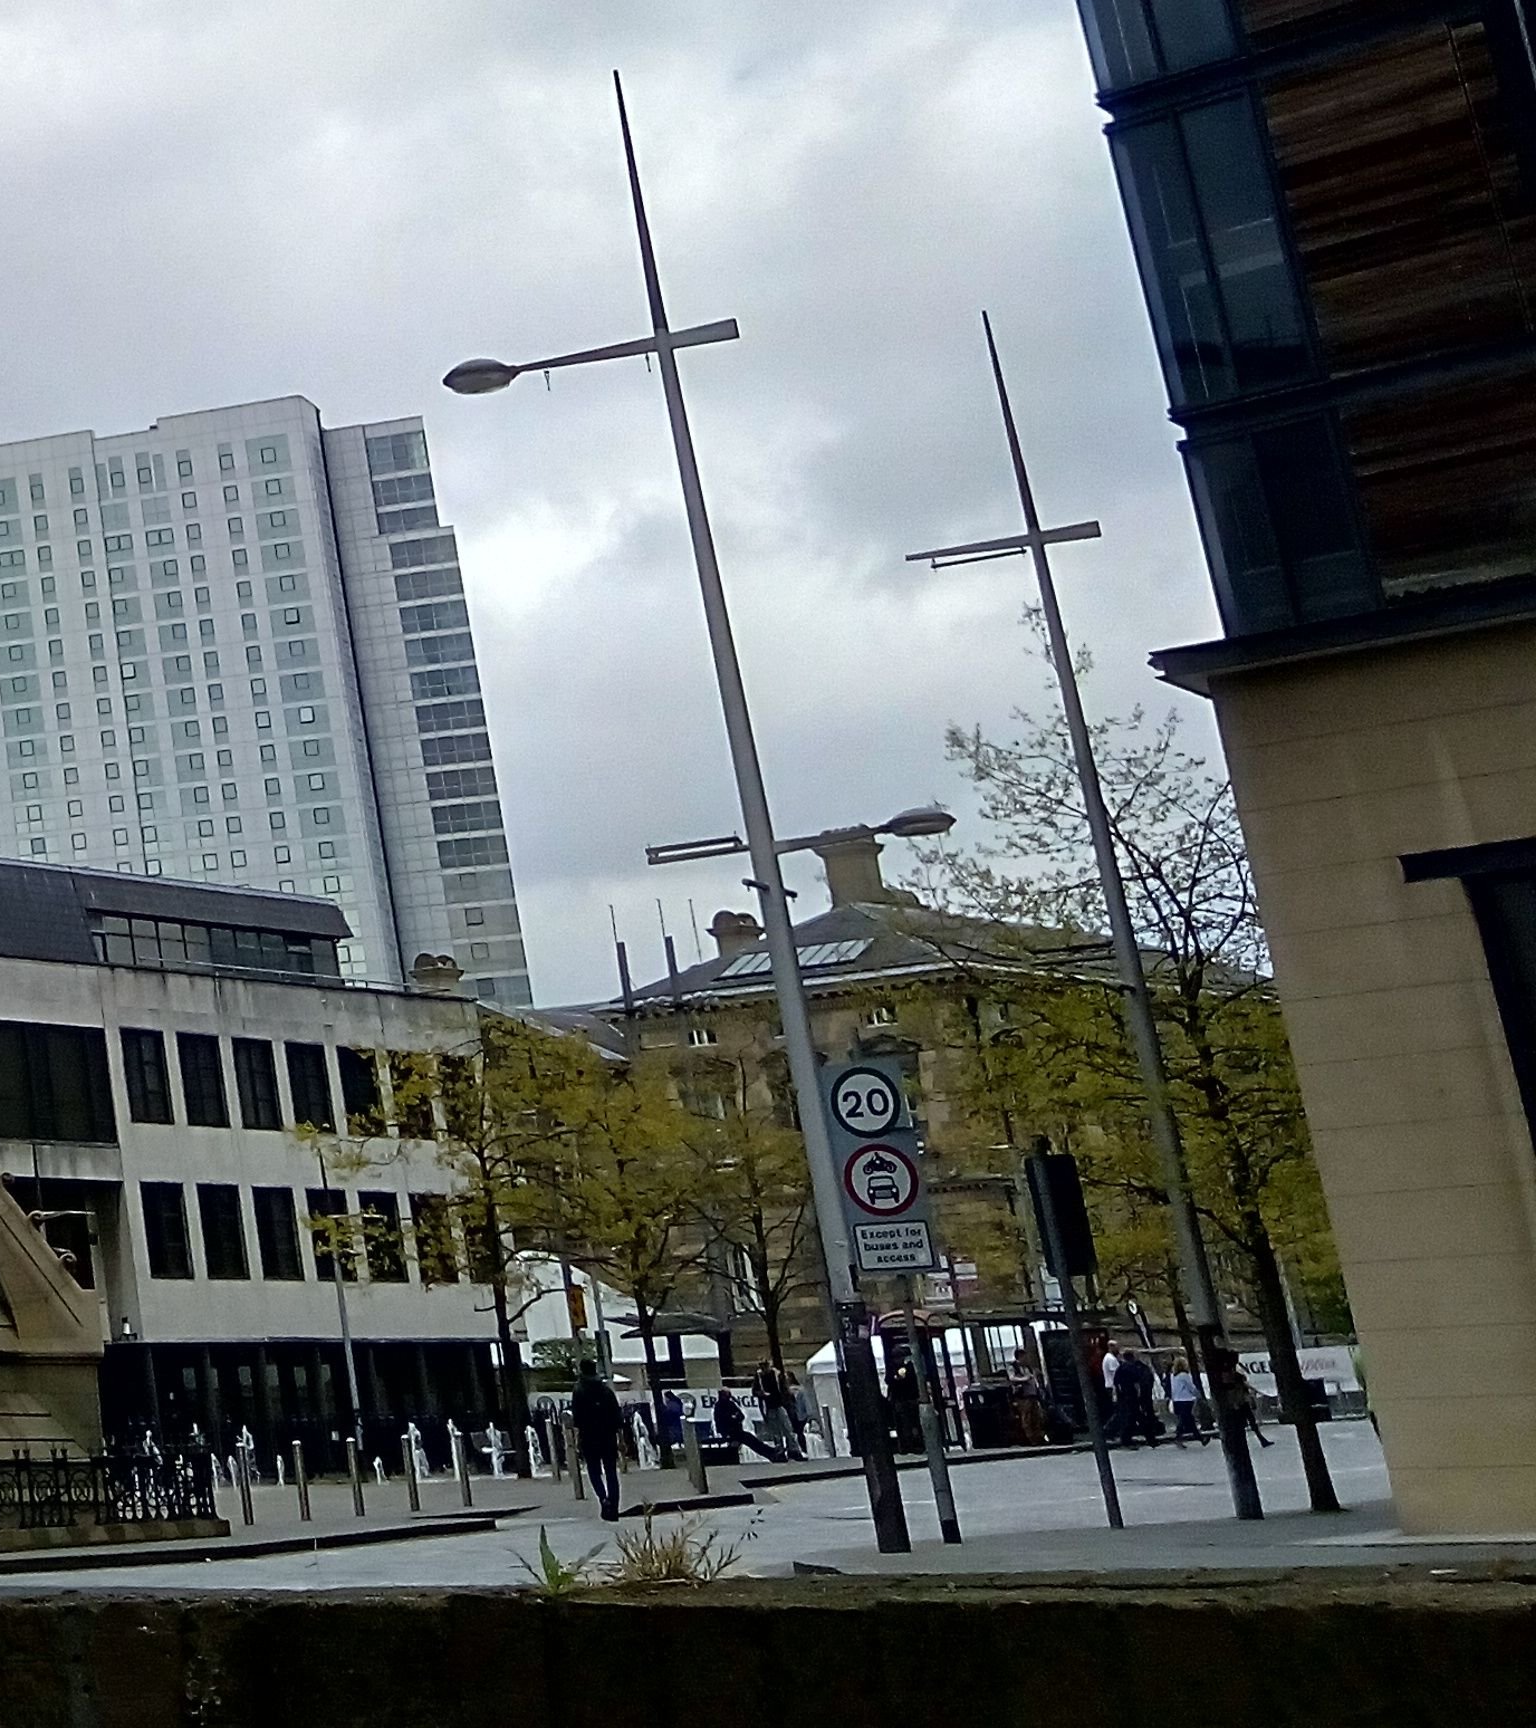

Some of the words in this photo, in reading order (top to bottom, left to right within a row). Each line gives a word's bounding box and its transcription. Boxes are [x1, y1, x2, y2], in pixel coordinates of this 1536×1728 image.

[842, 1088, 889, 1118] 20
[861, 1228, 902, 1239] Except
[905, 1227, 921, 1237] for
[864, 1241, 899, 1251] buses
[903, 1238, 924, 1249] and
[877, 1254, 916, 1263] access
